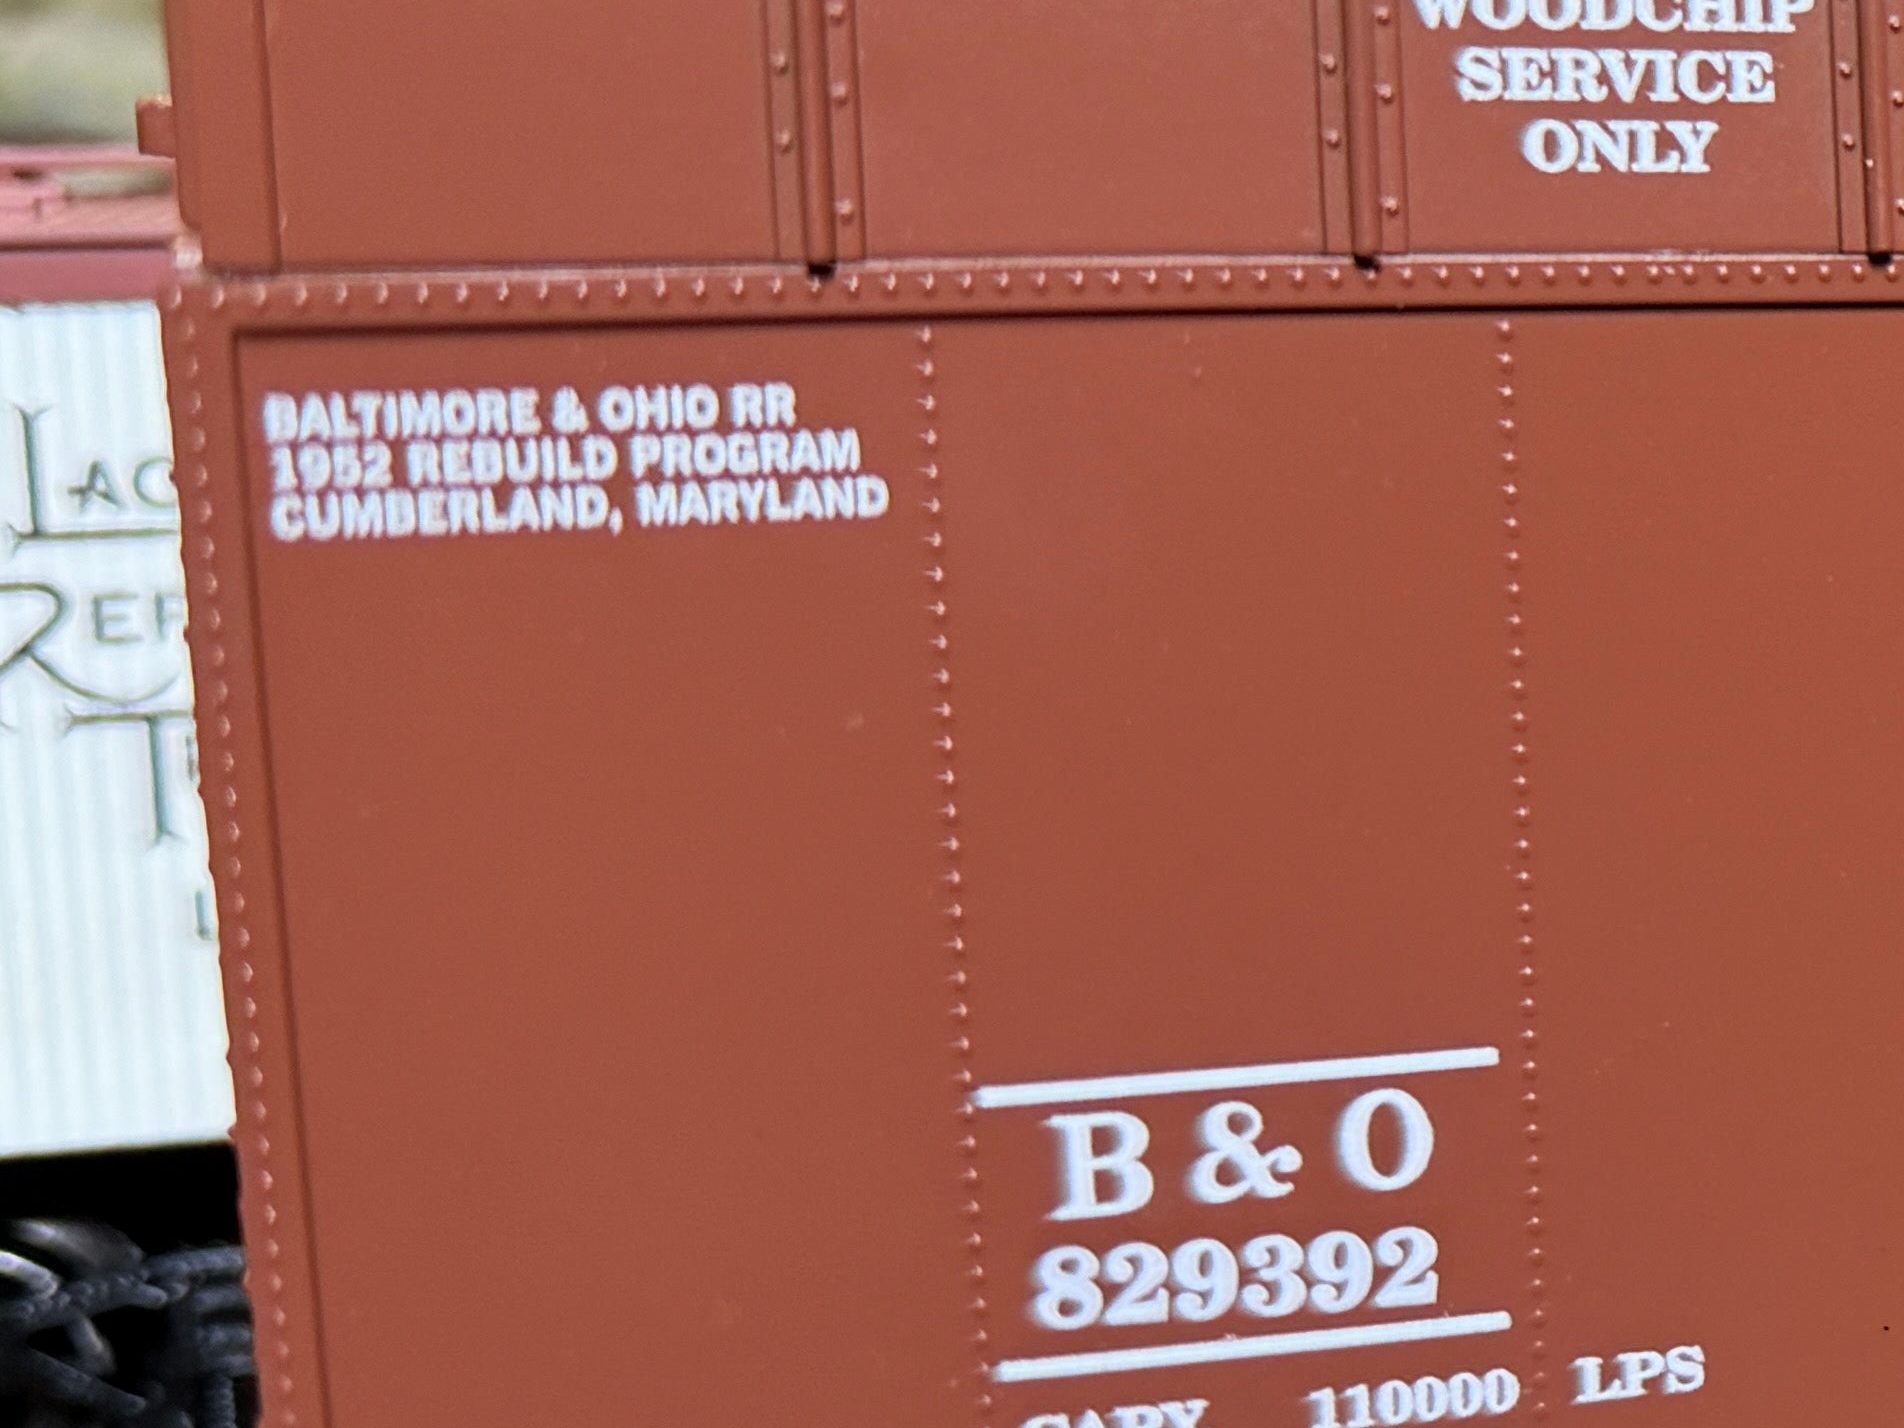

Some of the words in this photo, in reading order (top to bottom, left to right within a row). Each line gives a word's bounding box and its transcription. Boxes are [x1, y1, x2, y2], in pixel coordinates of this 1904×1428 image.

[1455, 46, 1775, 104] SERVICE
[1521, 119, 1719, 173] ONLY
[263, 388, 541, 445] BALTIMORE
[552, 387, 589, 434] &
[598, 384, 719, 432] OHIO
[729, 383, 796, 428] RR
[271, 440, 392, 490] 1952
[406, 435, 618, 486] REBUILD
[629, 428, 860, 479] PROGRAM
[271, 484, 622, 541] CUMBERLAND,
[635, 475, 889, 526] MARYLAND
[1033, 1227, 1438, 1330] 829392
[1573, 1345, 1705, 1403] LPS
